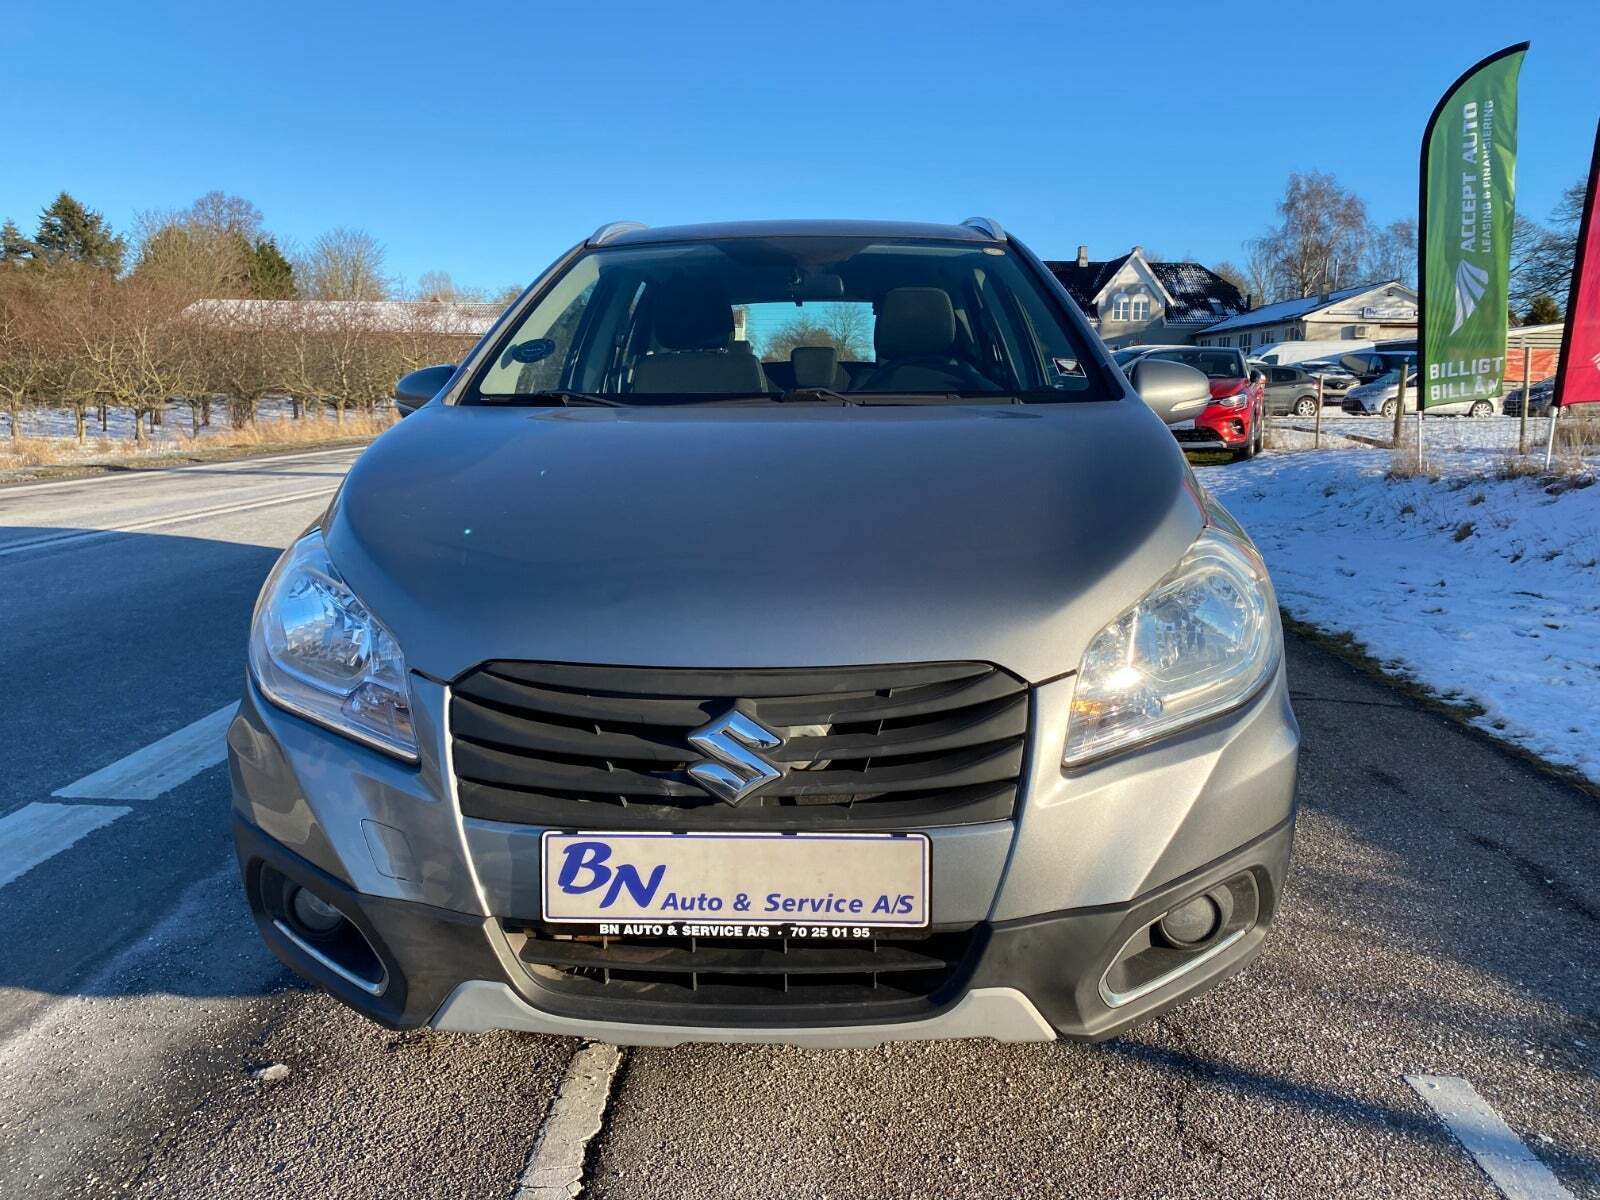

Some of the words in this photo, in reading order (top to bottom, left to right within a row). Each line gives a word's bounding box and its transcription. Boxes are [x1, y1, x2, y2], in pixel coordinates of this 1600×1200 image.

[1463, 101, 1478, 165] AUTO
[1482, 99, 1494, 188] FINANSIERING
[1460, 172, 1477, 253] ACCEPT
[1482, 203, 1492, 253] LEASING
[1430, 356, 1504, 380] BILLIGT
[1430, 375, 1499, 400] BILLÅN
[558, 841, 667, 909] BN
[660, 892, 723, 912] Auto
[733, 893, 751, 911] &
[764, 893, 864, 913] Service
[871, 894, 914, 914] A/S
[600, 924, 620, 935] BN
[623, 924, 663, 935] AUTO
[666, 925, 678, 936] &
[682, 925, 744, 937] SERVICE
[747, 926, 770, 937] A/S
[790, 927, 807, 938] 70
[811, 927, 828, 938] 25
[832, 927, 848, 938] 01
[852, 927, 871, 938] 95
